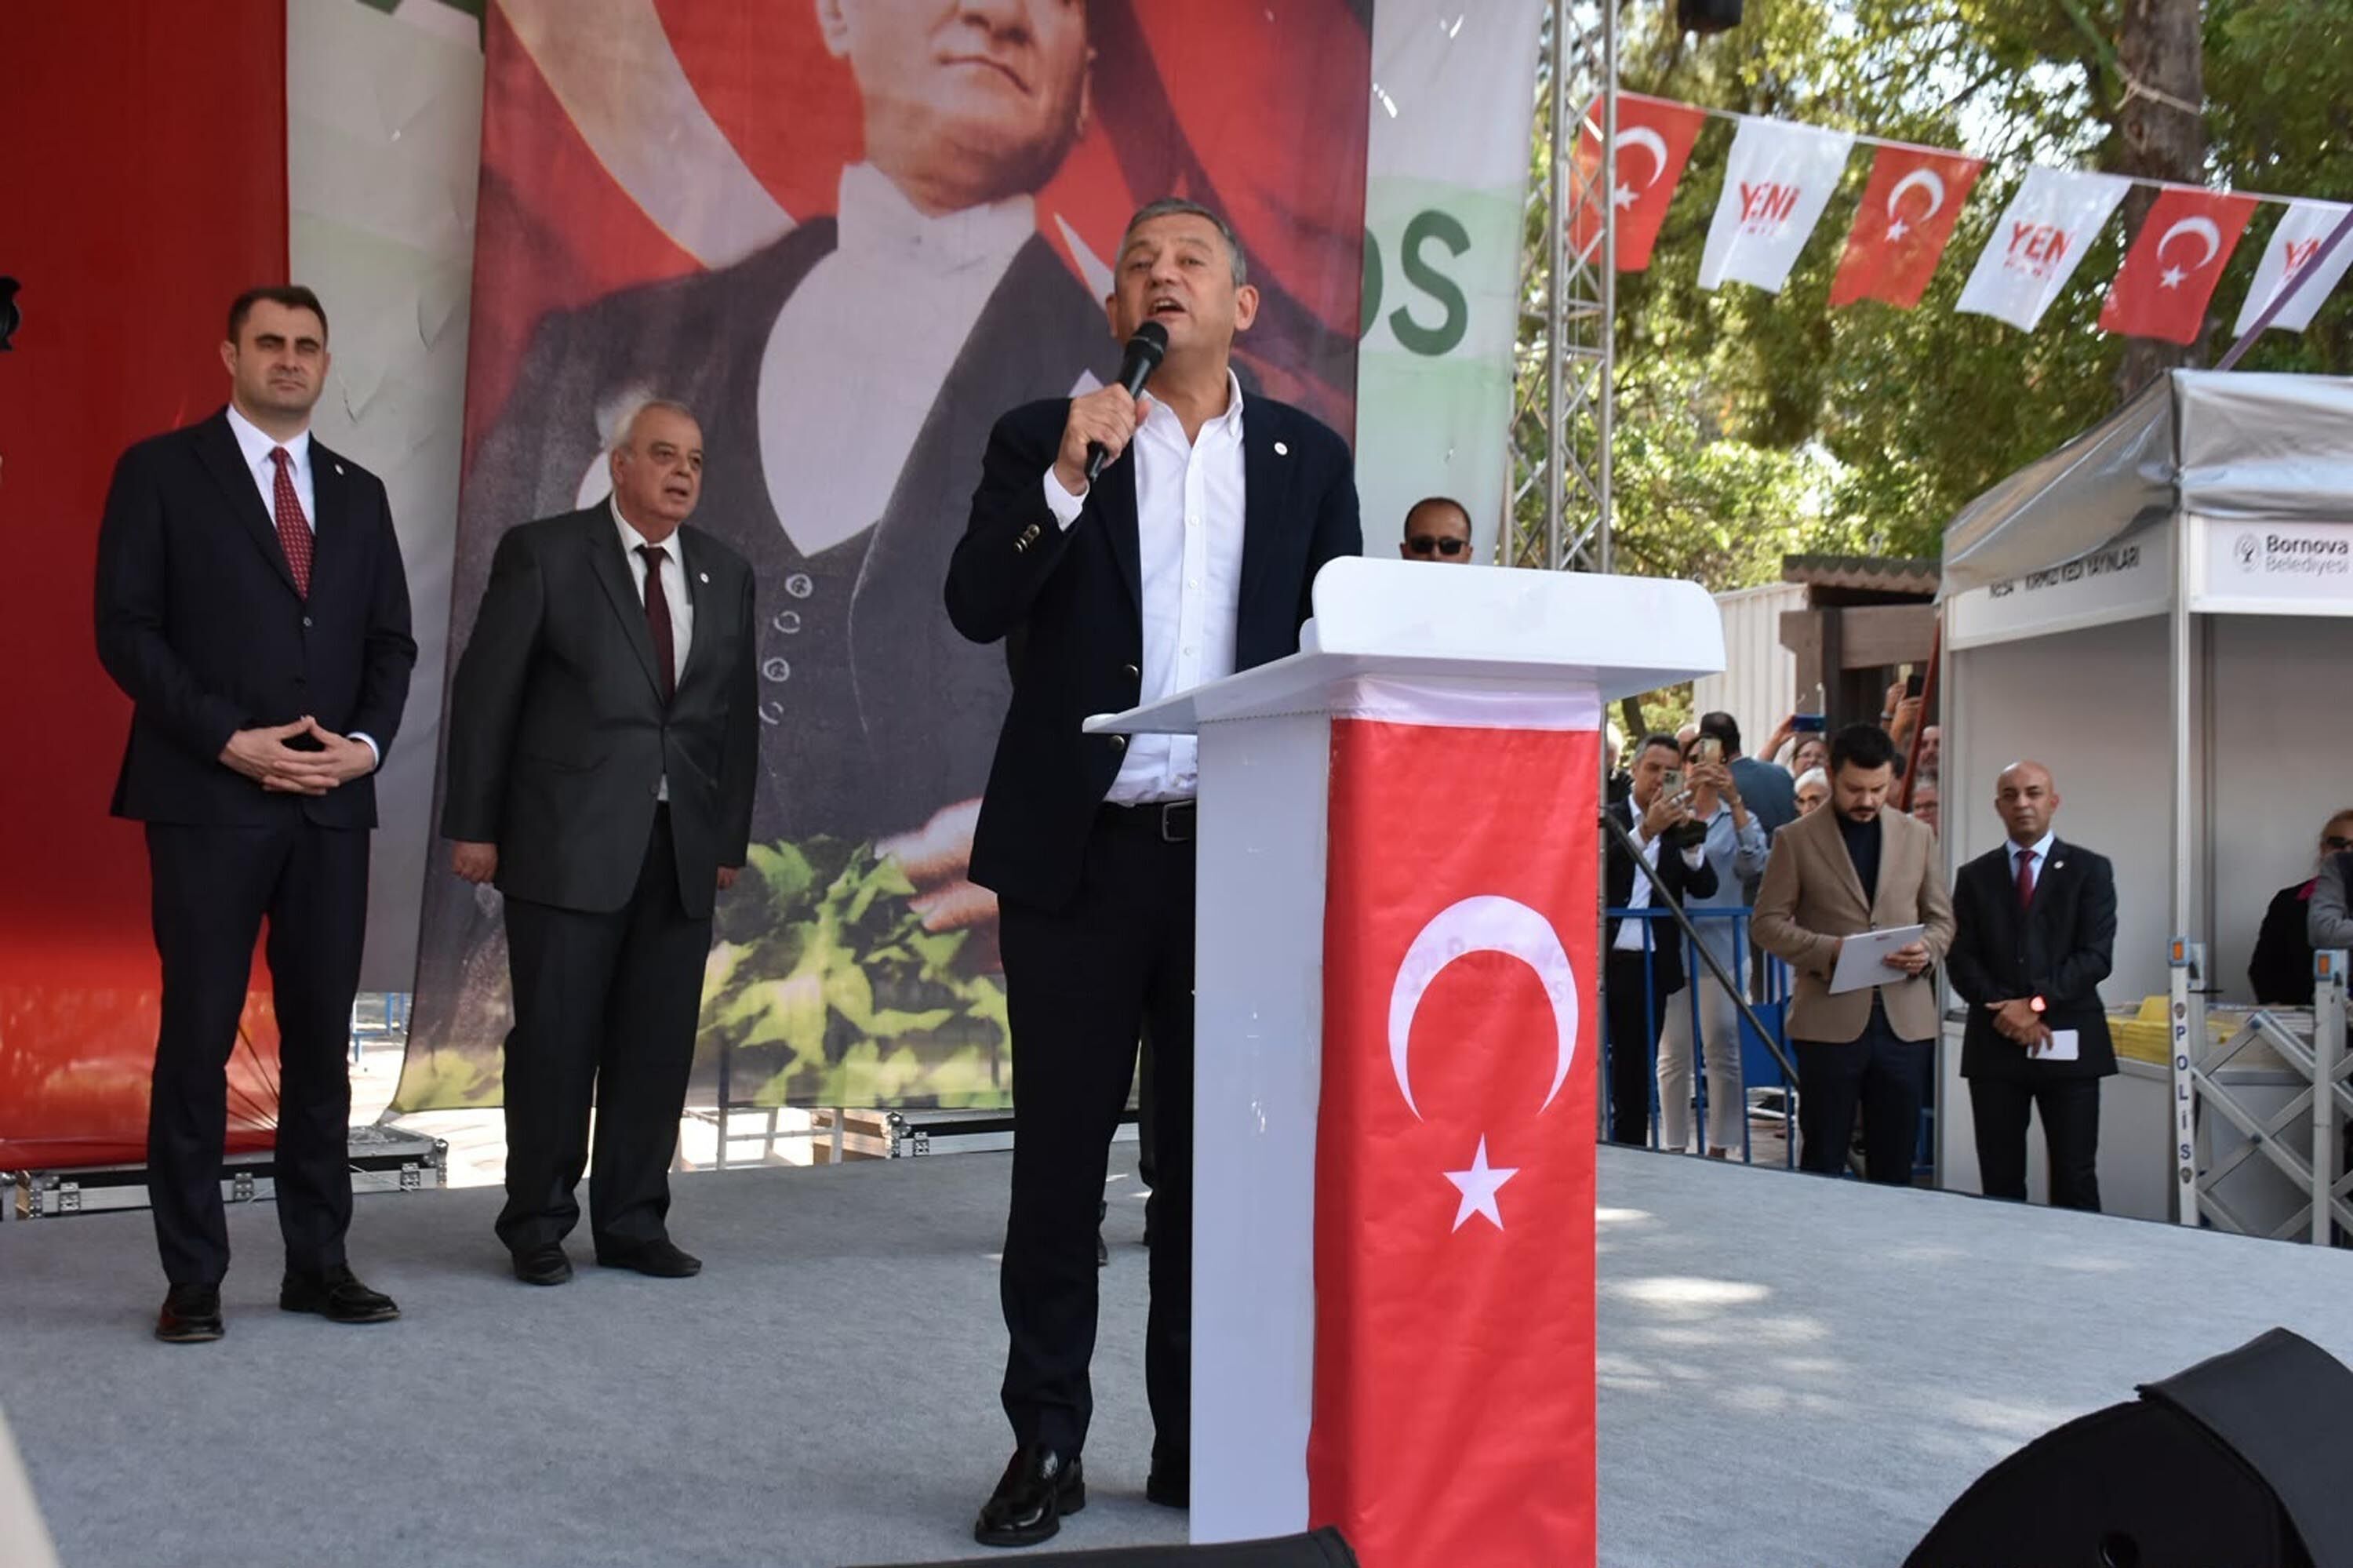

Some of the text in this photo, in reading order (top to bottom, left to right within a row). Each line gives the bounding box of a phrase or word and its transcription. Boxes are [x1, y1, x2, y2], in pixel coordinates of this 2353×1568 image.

[2008, 220, 2076, 264] YEN
[1360, 209, 1471, 356] S
[2267, 534, 2349, 555] Bornova
[2267, 555, 2348, 577] Belediyesi
[2176, 1025, 2192, 1161] POLİS
